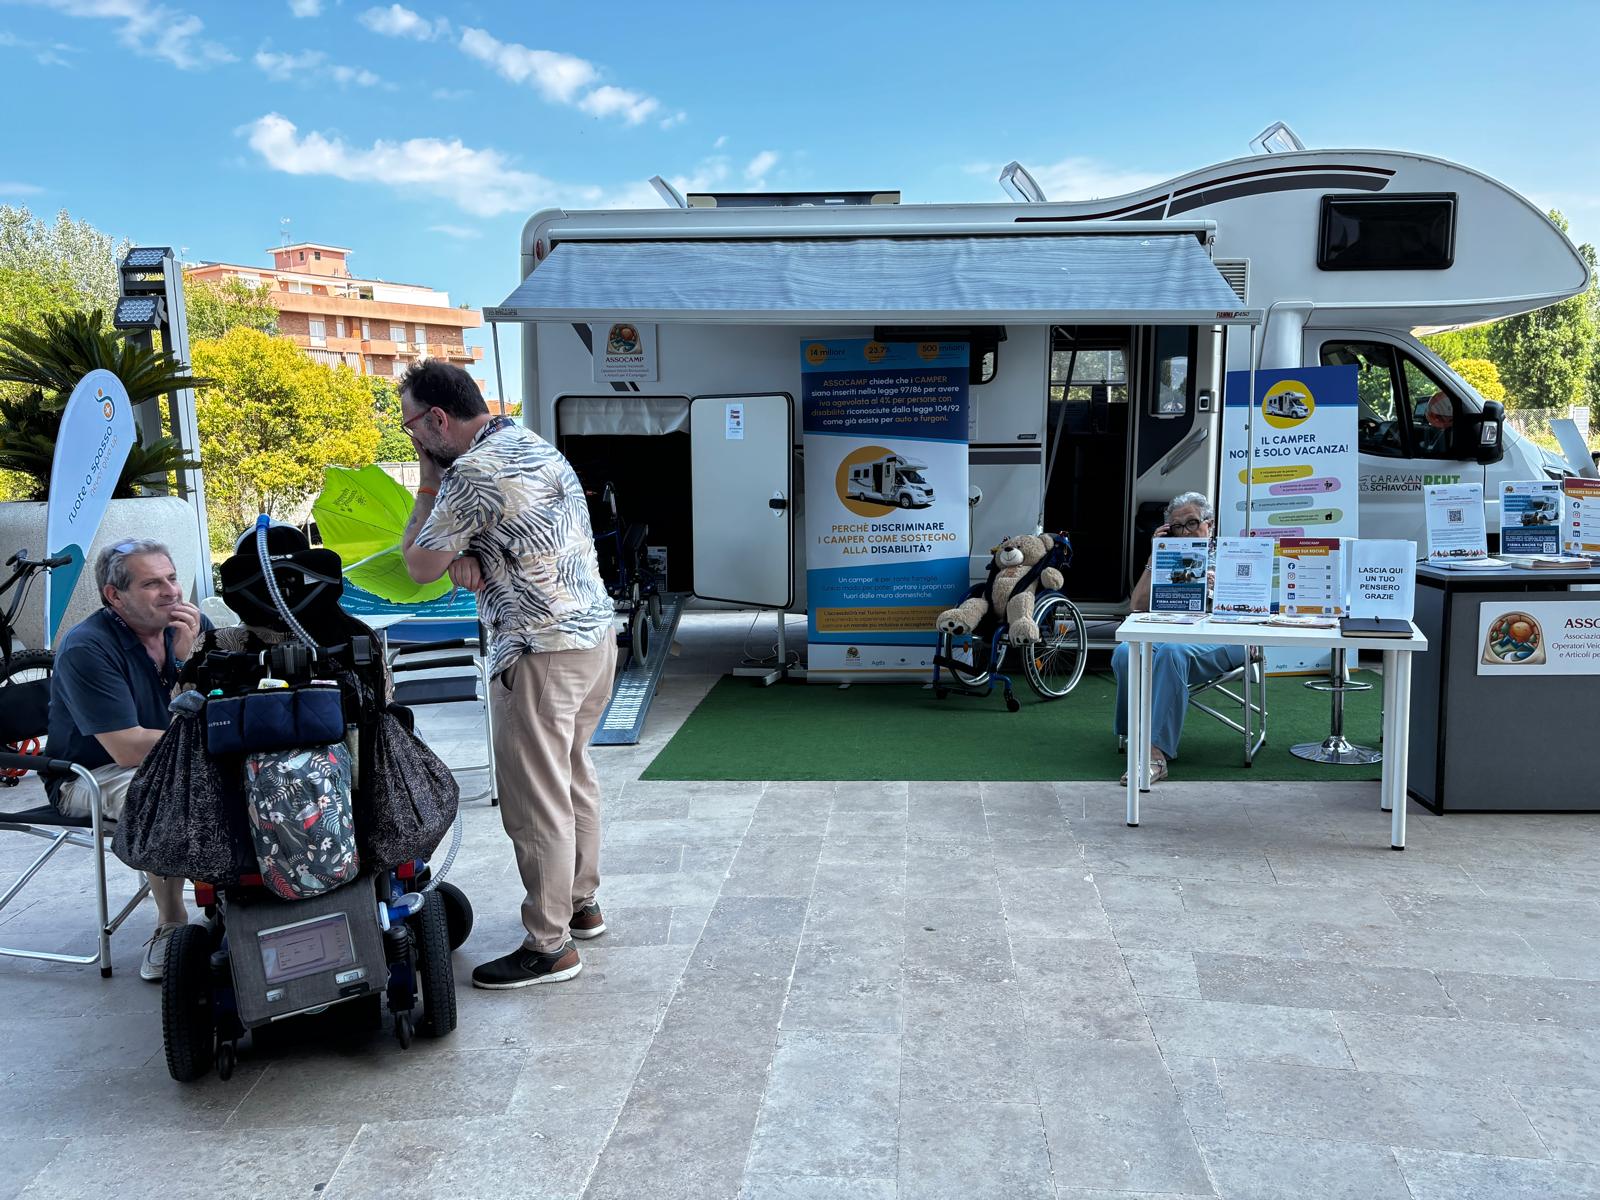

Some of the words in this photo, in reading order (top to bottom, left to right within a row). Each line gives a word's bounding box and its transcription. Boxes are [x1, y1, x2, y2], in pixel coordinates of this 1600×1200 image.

[823, 379, 867, 388] ASSOCAMP
[869, 377, 894, 385] chiede
[895, 376, 909, 384] che
[914, 375, 948, 383] CAMPER
[811, 389, 830, 397] siano
[832, 387, 857, 396] inseriti
[858, 387, 877, 395] nella
[878, 387, 898, 397] legge
[900, 386, 922, 394] 97/86
[923, 387, 936, 395] per
[832, 398, 870, 408] agevolata
[880, 397, 891, 405] 4%
[892, 397, 905, 406] per
[907, 396, 937, 405] persone
[938, 395, 952, 403] con
[847, 406, 890, 415] riconosciute
[892, 405, 911, 414] dalla
[912, 405, 934, 415] legge
[935, 404, 960, 413] 104/92
[822, 418, 844, 426] come
[858, 416, 879, 425] esiste
[880, 417, 894, 425] per
[895, 415, 912, 423] auto
[1261, 436, 1270, 445] IL
[1272, 434, 1316, 444] CAMPER
[1254, 447, 1260, 457] È
[1263, 447, 1290, 457] SOLO
[1294, 444, 1349, 455] VACANZA!
[68, 486, 87, 524] ruote
[91, 426, 112, 473] spasso
[1370, 475, 1422, 483] CARAVAN
[1370, 484, 1421, 492] SCHIAVOLIN
[871, 522, 944, 533] DISCRIMINARE
[823, 535, 865, 544] CAMPER
[867, 534, 897, 543] COME
[900, 533, 957, 542] SOSTEGNO
[842, 546, 868, 554] ALLA
[871, 543, 932, 554] DISABILITÀ?
[1359, 583, 1400, 591] PENSIERO
[1551, 642, 1586, 651] Operatori
